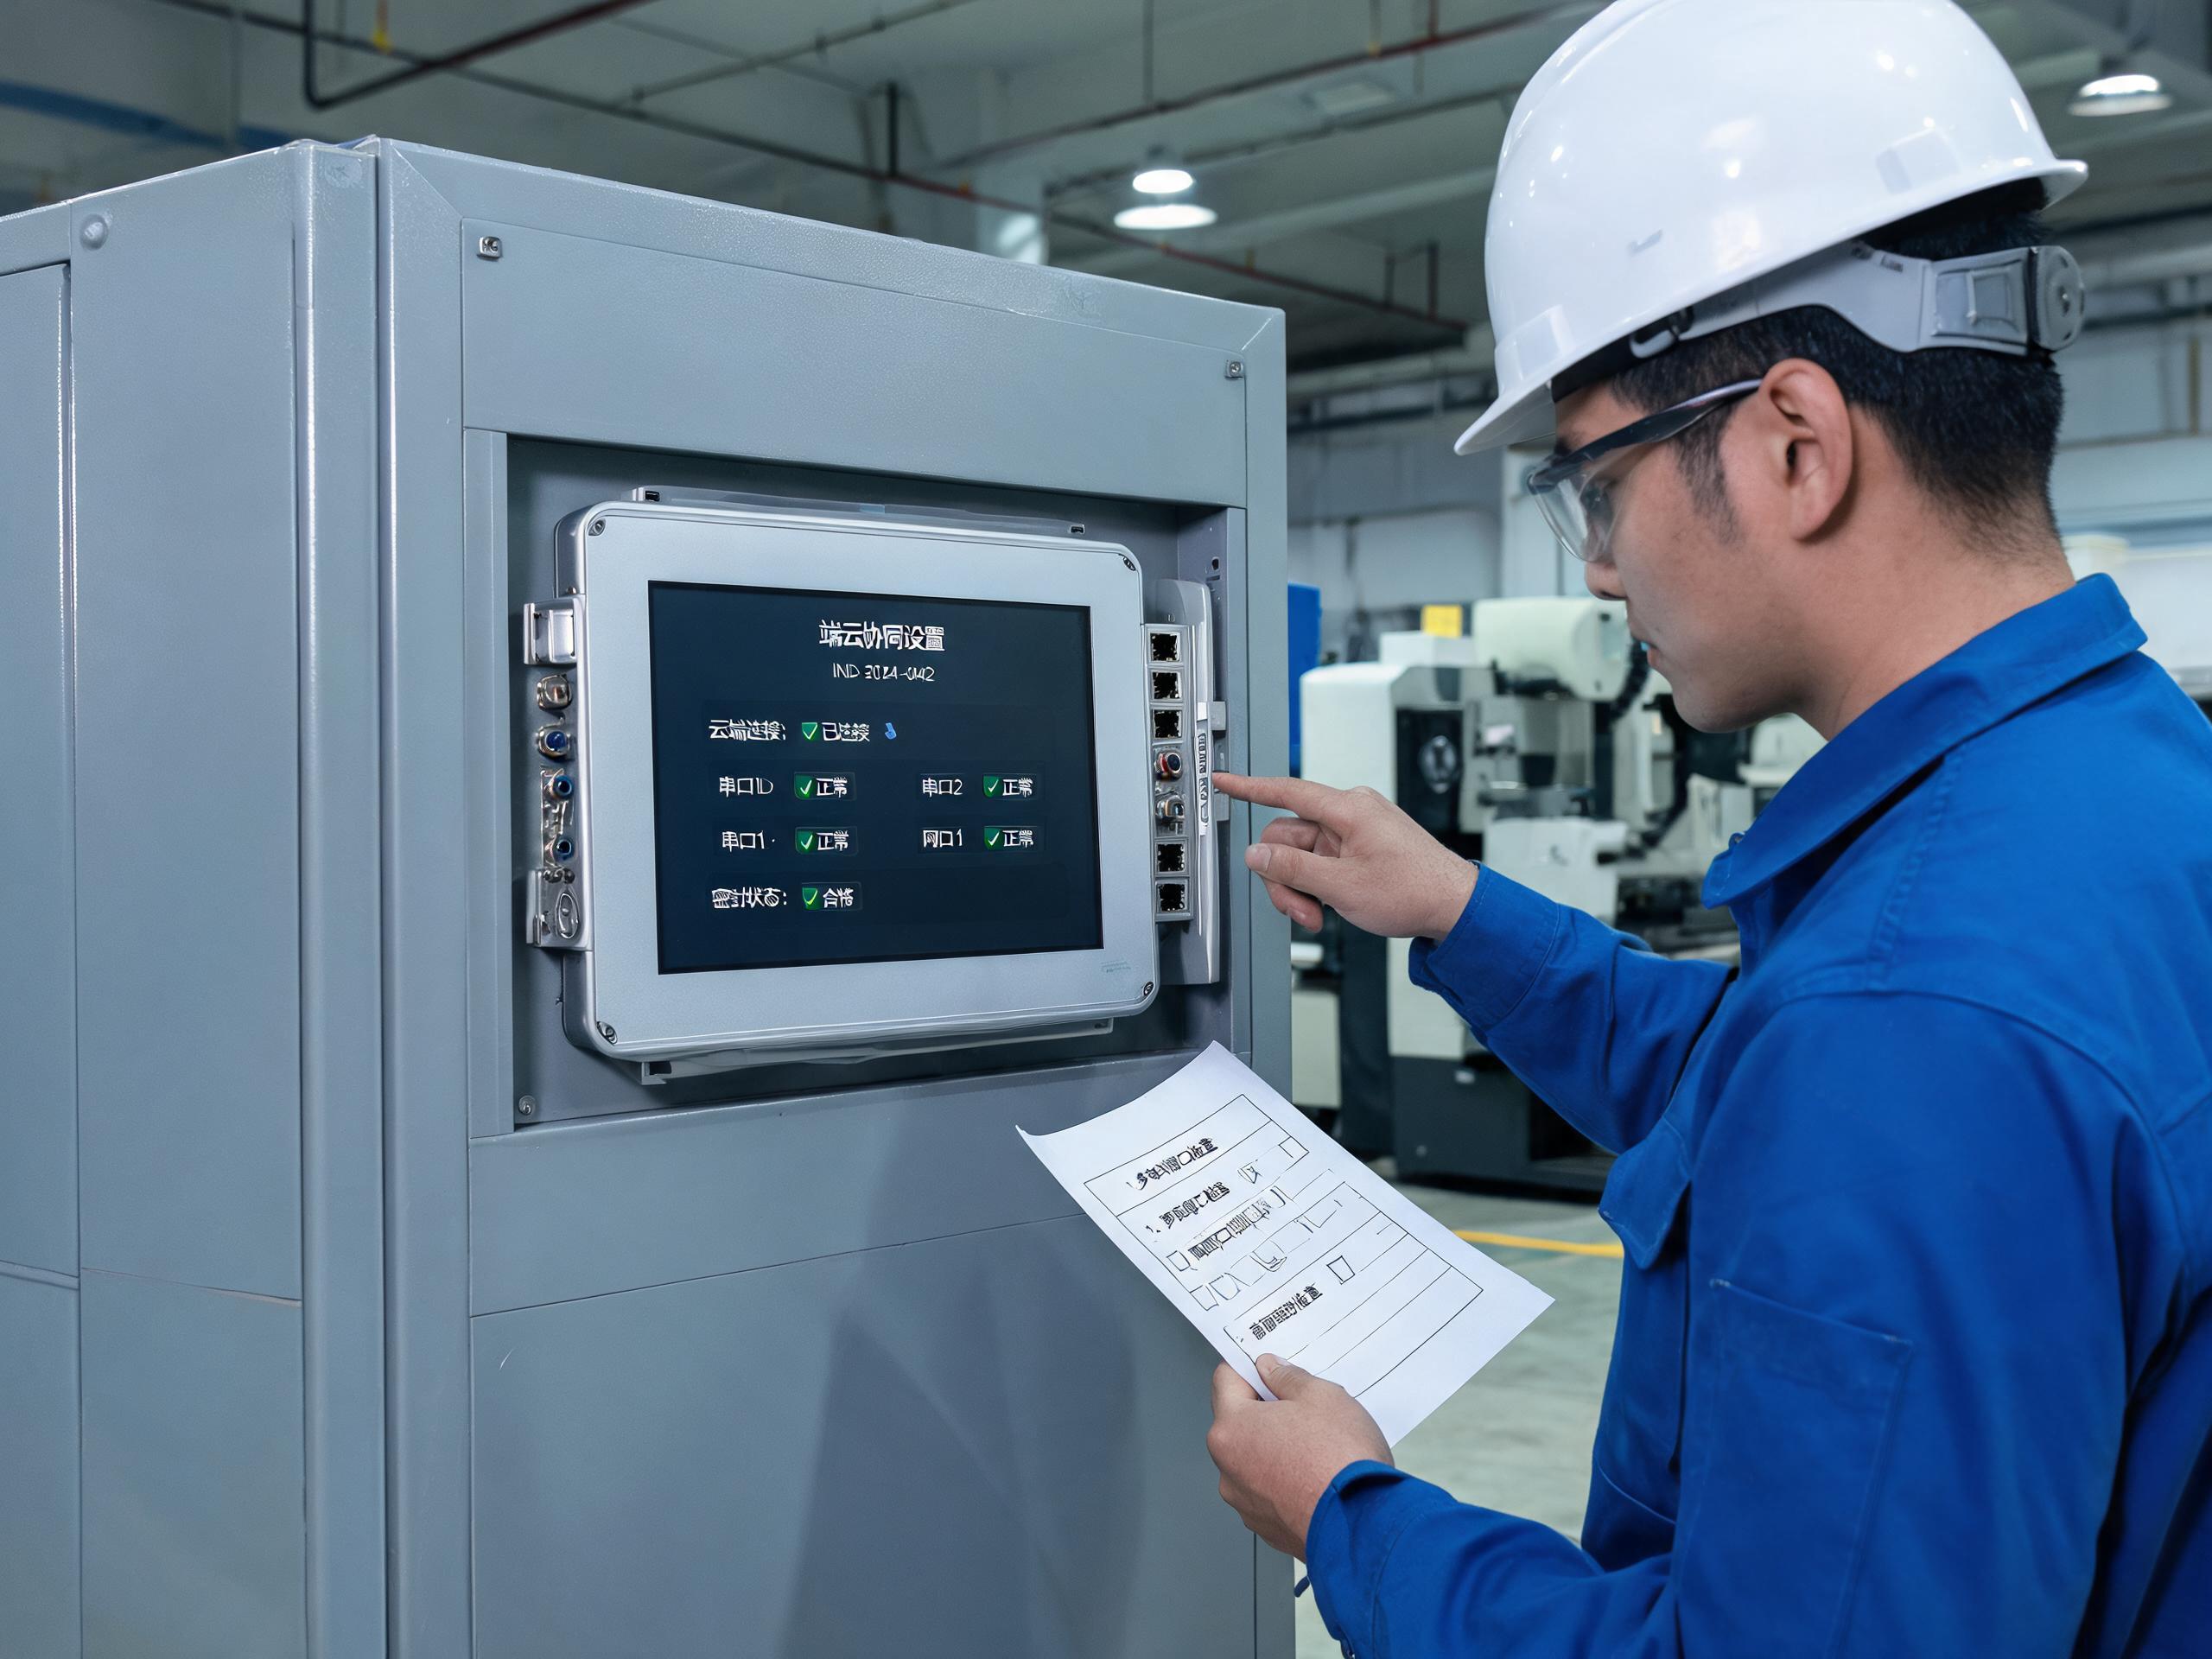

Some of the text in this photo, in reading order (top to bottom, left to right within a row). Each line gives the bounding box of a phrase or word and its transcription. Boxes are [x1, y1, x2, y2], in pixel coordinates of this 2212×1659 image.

[816, 777, 849, 798] 正常
[922, 778, 1033, 798] 串口2 正常
[816, 830, 849, 852] 正常
[923, 829, 1034, 849] 网口1 正常
